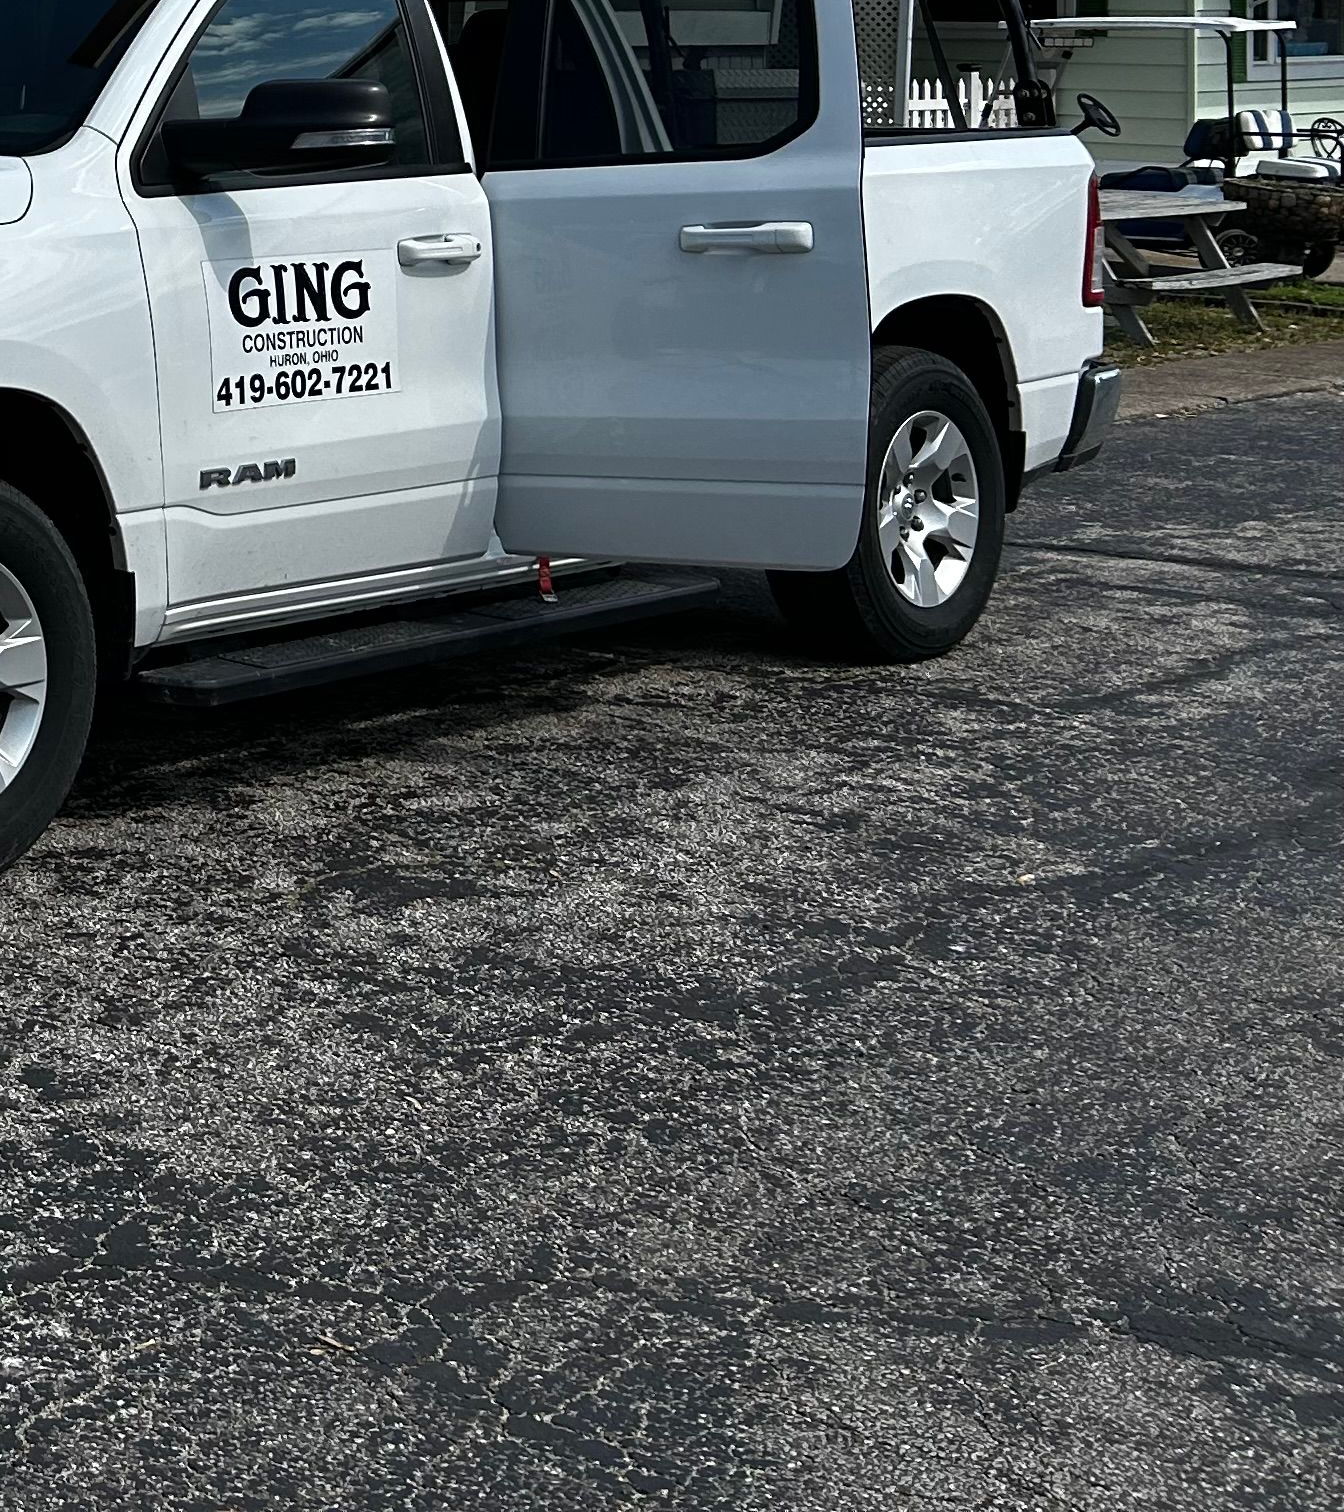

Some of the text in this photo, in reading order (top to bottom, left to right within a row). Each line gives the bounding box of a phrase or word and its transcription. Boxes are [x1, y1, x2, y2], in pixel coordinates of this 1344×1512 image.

[228, 259, 371, 327] GING
[242, 325, 363, 353] CONSTRUCTION
[269, 349, 339, 367] HURON, OHIO
[216, 361, 392, 406] 419-602-7221
[199, 457, 296, 490] RAM
